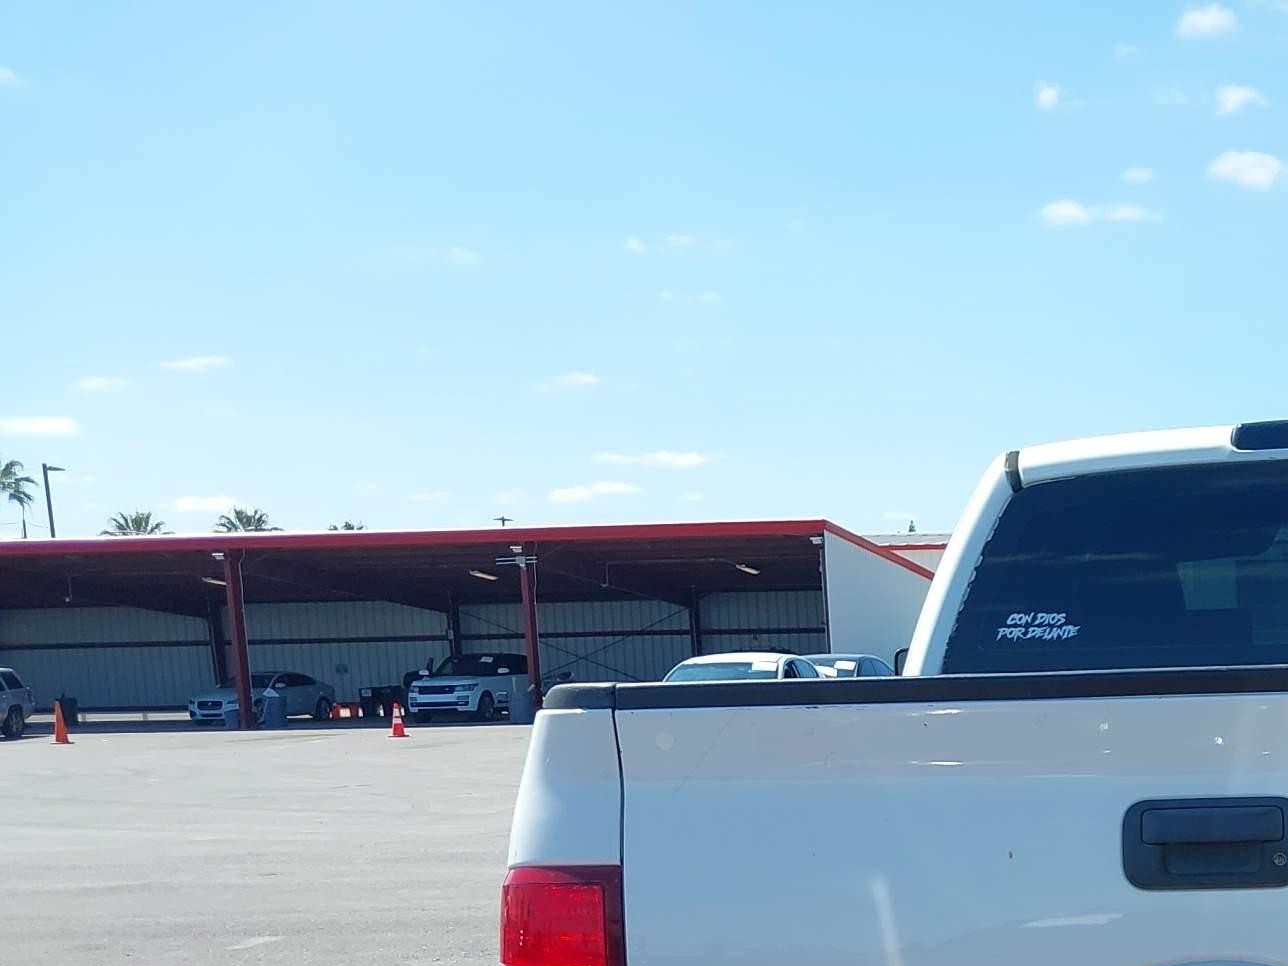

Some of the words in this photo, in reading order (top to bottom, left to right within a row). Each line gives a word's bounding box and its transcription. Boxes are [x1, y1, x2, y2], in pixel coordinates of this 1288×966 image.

[1006, 612, 1035, 626] CON
[1032, 613, 1067, 626] DIOS
[996, 627, 1026, 642] POR
[1023, 625, 1081, 641] DELANTE
